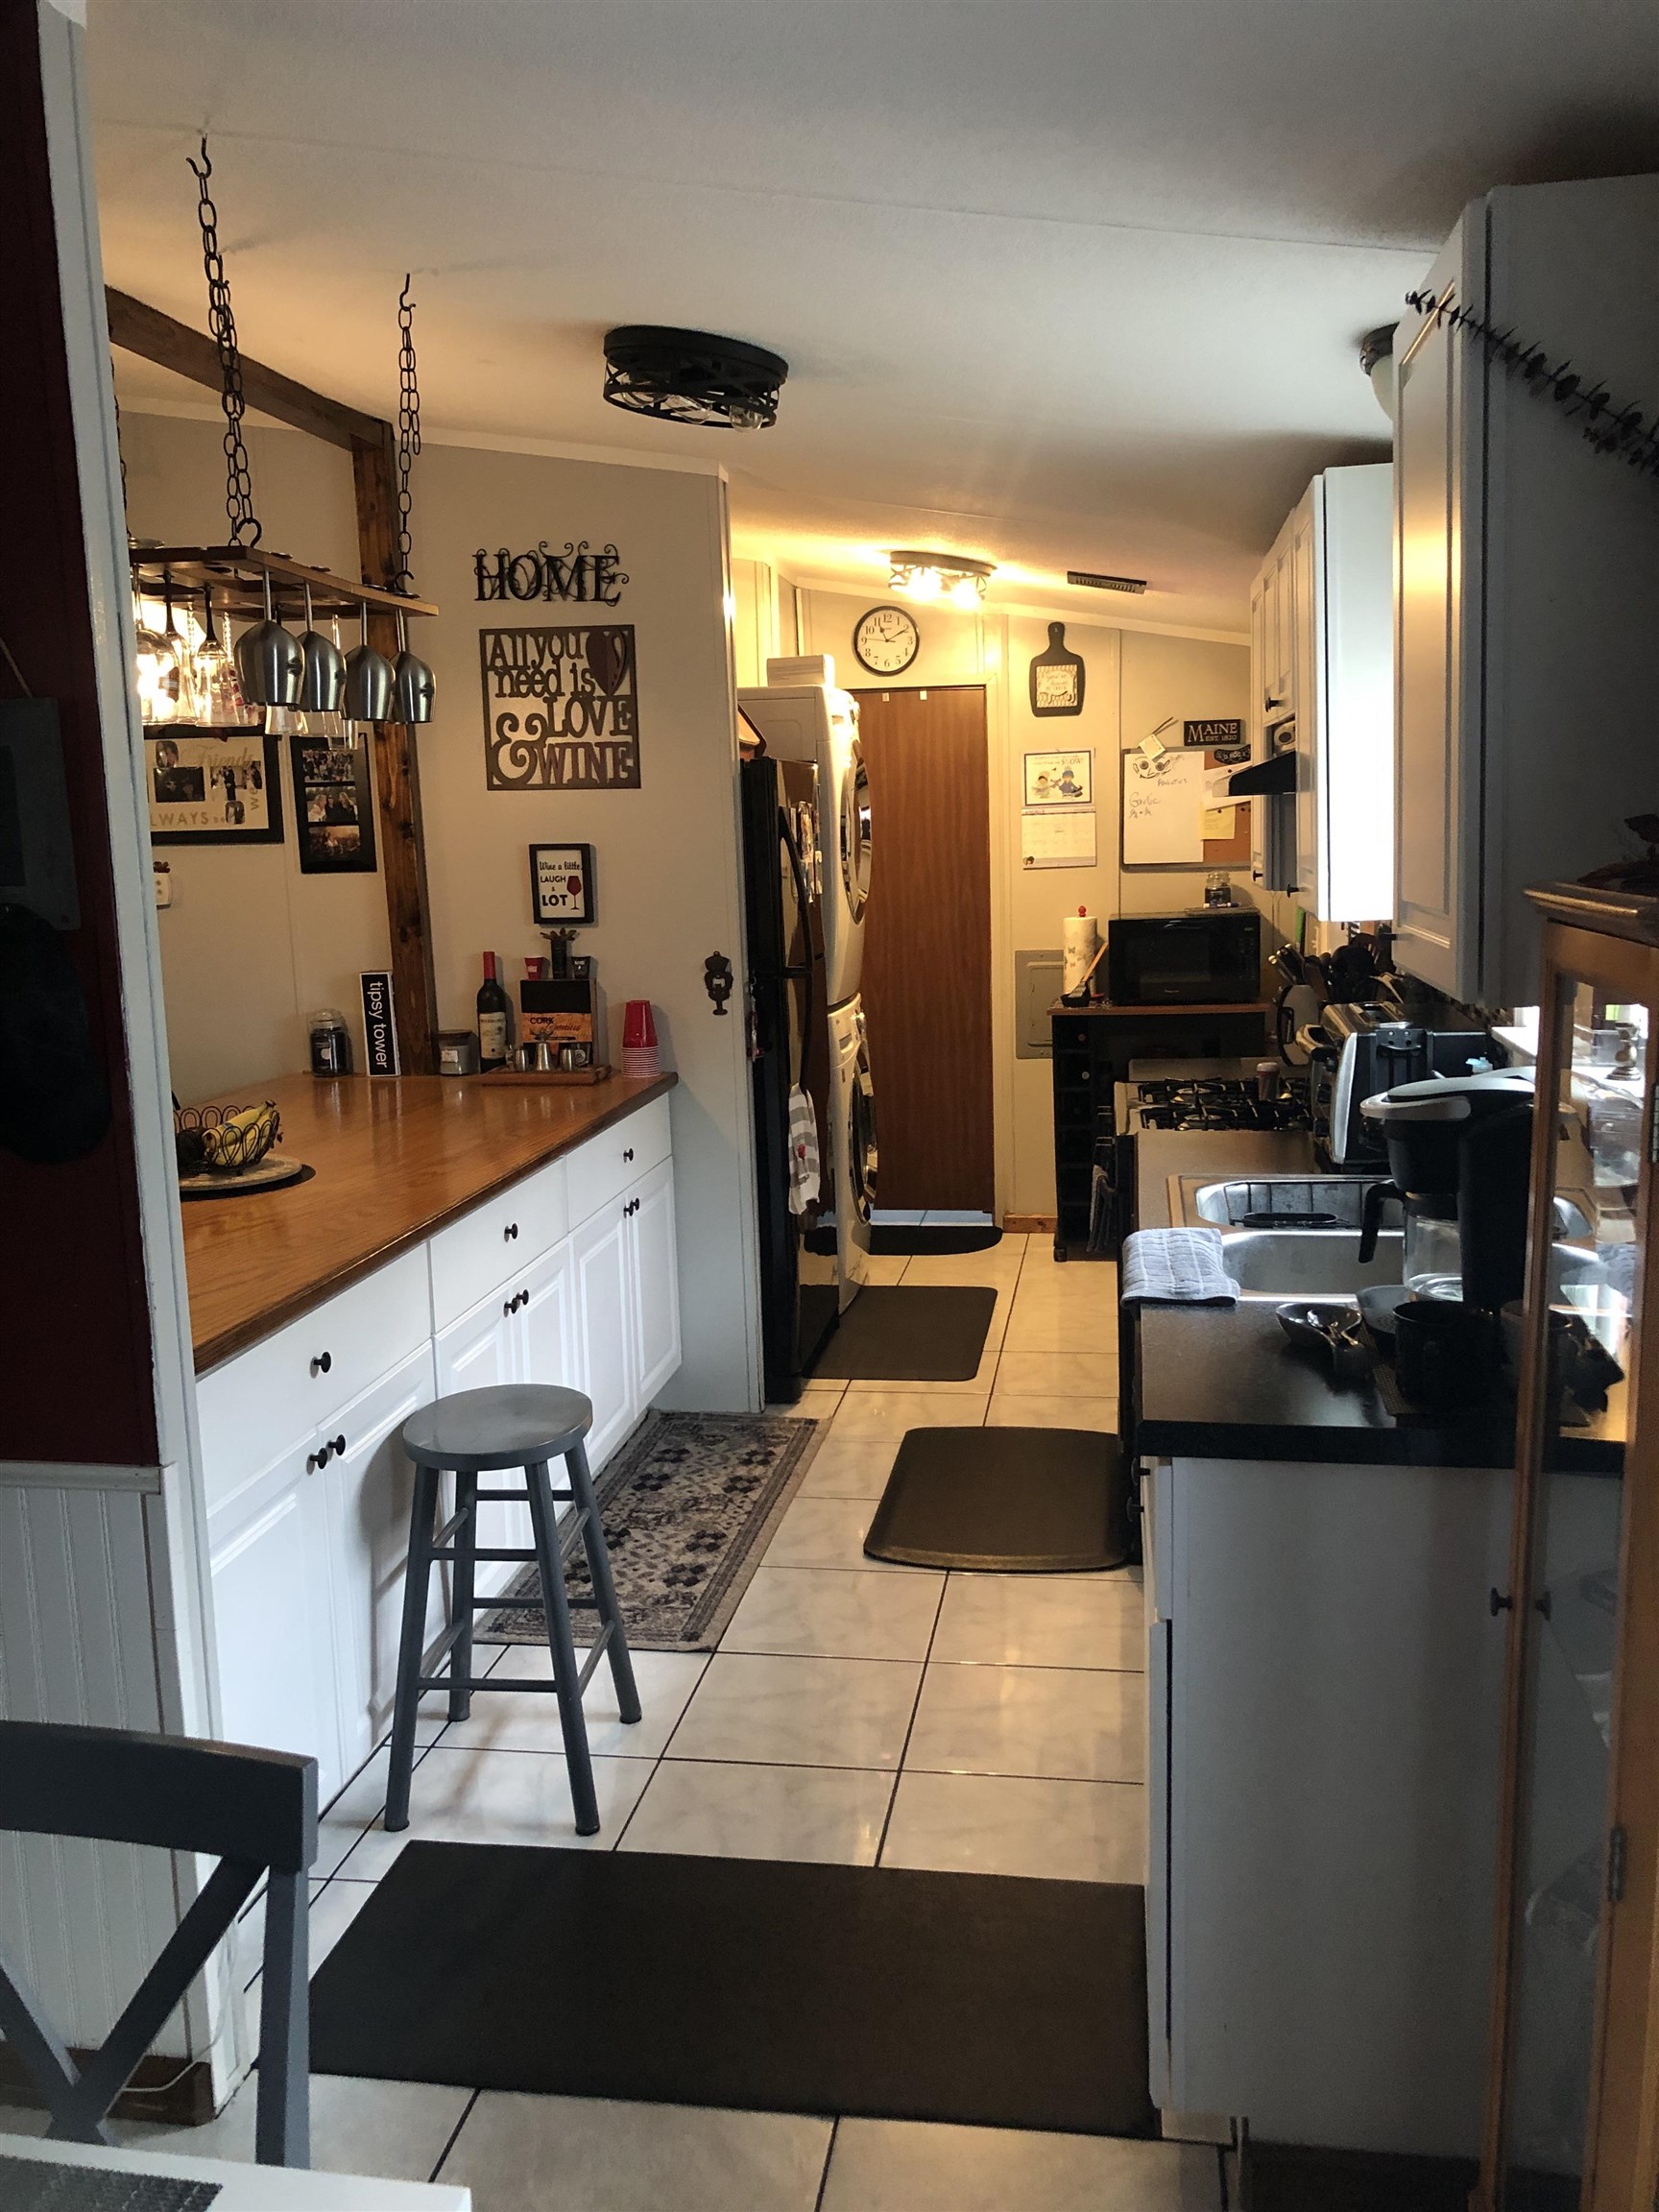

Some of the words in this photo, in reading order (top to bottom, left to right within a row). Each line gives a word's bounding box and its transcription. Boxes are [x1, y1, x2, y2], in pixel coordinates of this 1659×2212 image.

[473, 543, 628, 606] HOME
[883, 613, 892, 623] 12
[896, 616, 900, 626] 1
[865, 625, 875, 635] 10
[861, 637, 868, 645] 9
[907, 636, 913, 645] 3
[487, 632, 529, 671] All
[529, 631, 584, 667] you
[865, 648, 871, 658] 8
[903, 647, 908, 657] 4
[874, 656, 878, 665] 7
[884, 659, 890, 667] 6
[896, 655, 902, 664] 5
[494, 660, 565, 698] need
[570, 662, 596, 697] is
[543, 695, 632, 737] LOVE
[1188, 722, 1238, 742] MAINE
[491, 711, 546, 784] &
[534, 741, 634, 784] WINE
[151, 811, 208, 827] LWAYS
[540, 861, 556, 871] Wine
[541, 894, 567, 906] LOT
[367, 981, 385, 1020] tipsy
[373, 1023, 387, 1069] tower
